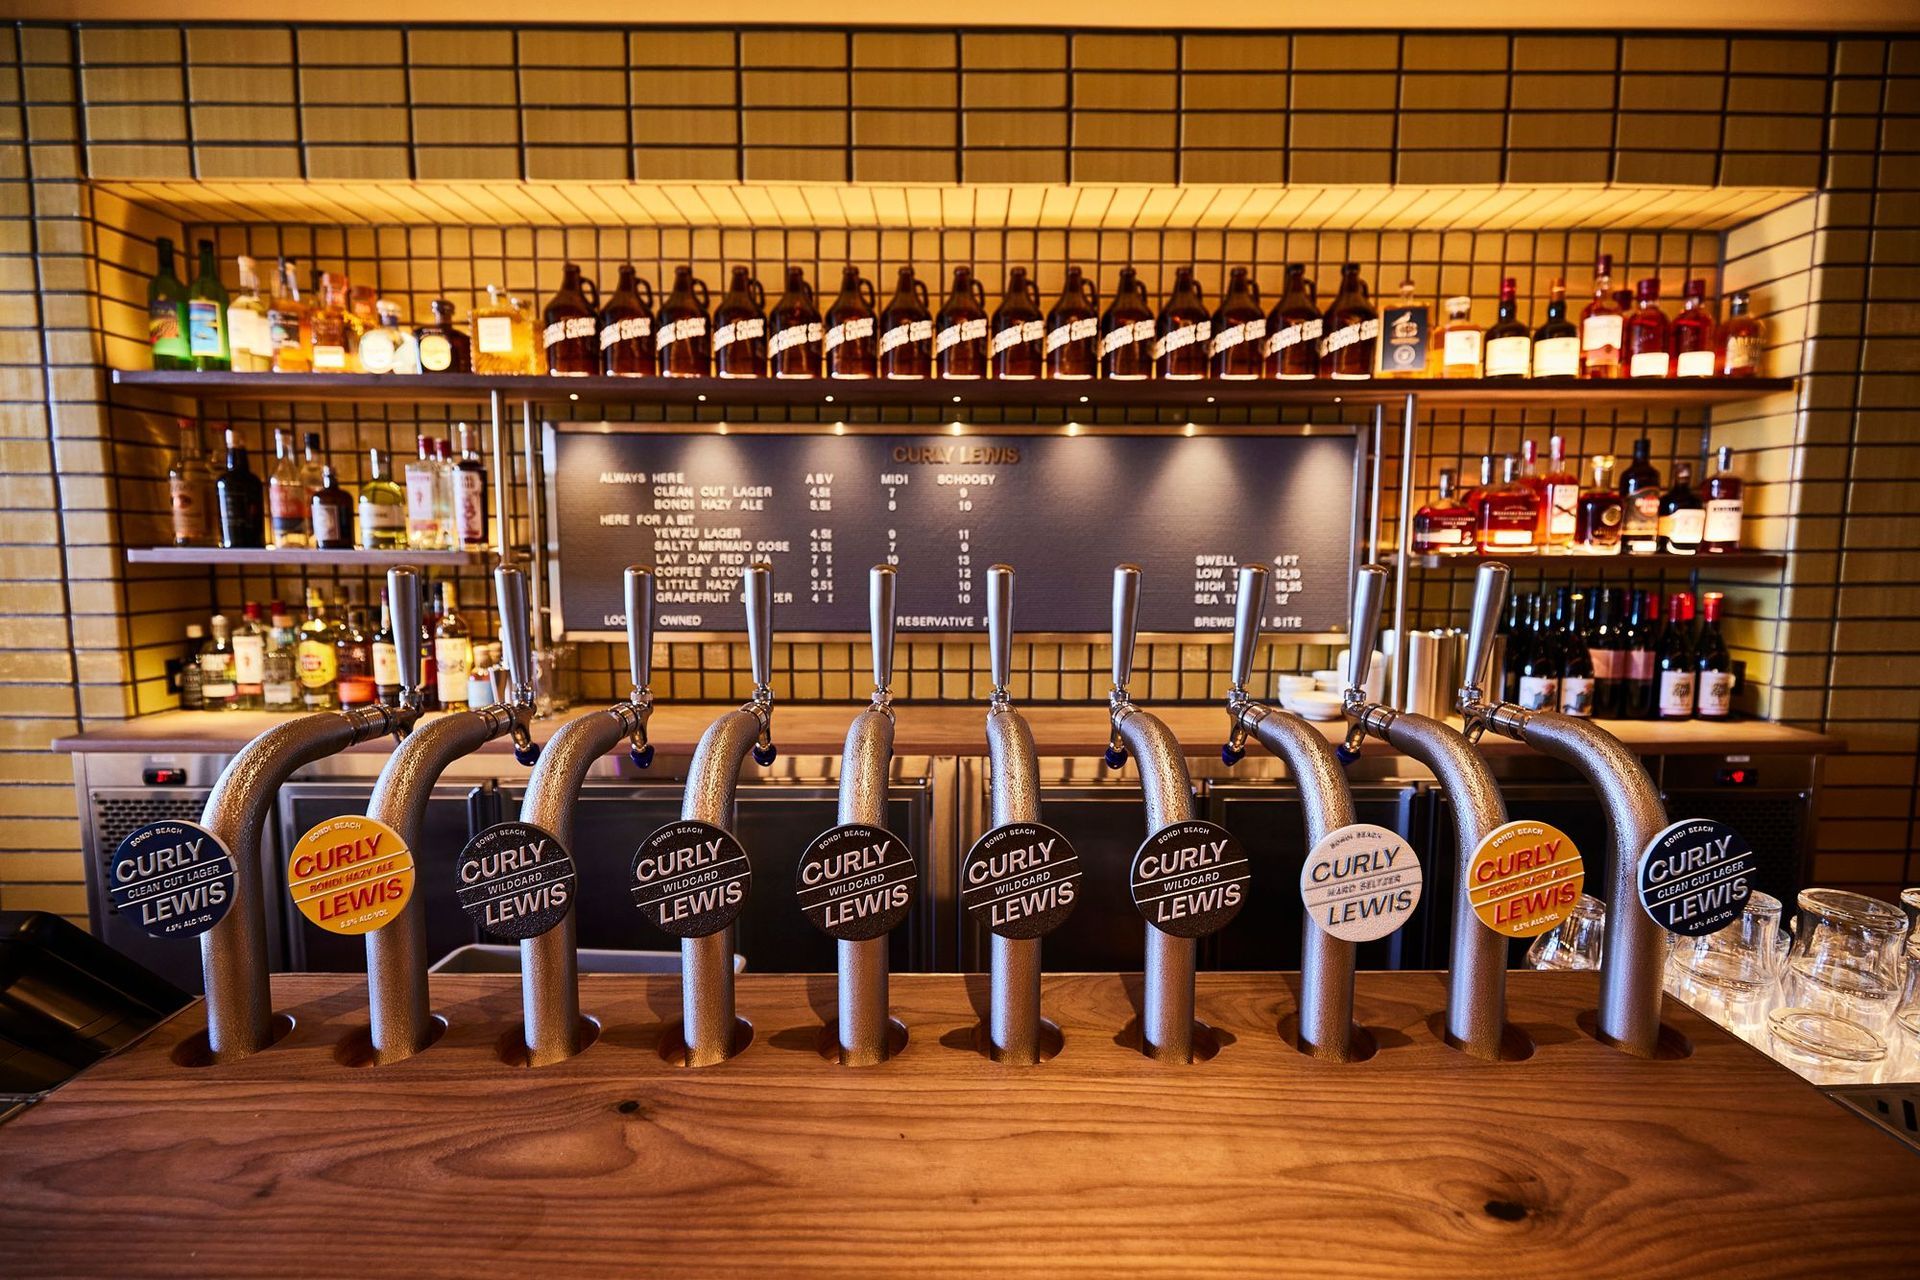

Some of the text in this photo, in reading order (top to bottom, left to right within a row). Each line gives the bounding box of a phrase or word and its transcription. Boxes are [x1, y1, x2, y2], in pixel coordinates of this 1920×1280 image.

[893, 446, 1020, 464] CURLY LEWIS
[600, 472, 684, 484] ALWAYS HERE
[804, 473, 834, 484] ABV
[881, 474, 908, 485] MIDI
[937, 474, 996, 485] SCHOOEY
[653, 486, 694, 497] CLEAN
[700, 486, 726, 497] CUT
[732, 486, 772, 497] LAGER
[889, 487, 896, 498] 7
[654, 499, 695, 510] BONDI
[701, 499, 732, 510] HAZY
[740, 499, 763, 510] ALE
[888, 500, 897, 511] 8
[959, 500, 973, 511] 10
[600, 514, 695, 526] HERE FOR A BIT
[654, 528, 699, 538] YEWZU
[704, 528, 741, 539] LAGER
[959, 529, 969, 540] 11
[654, 541, 694, 551] SALTY
[698, 541, 752, 551] MERMAID
[757, 541, 790, 552] GOSE
[889, 542, 896, 552] 7
[656, 553, 680, 564] LAY
[687, 553, 712, 564] DAY
[719, 553, 744, 564] RED
[750, 554, 772, 564] IPA
[887, 555, 899, 565] 10
[958, 555, 970, 566] 13
[1195, 555, 1237, 566] SWELL
[654, 566, 702, 577] COFFEE
[710, 566, 744, 577] STOU
[958, 568, 971, 579] 12
[1196, 568, 1223, 579] LOW
[656, 579, 699, 590] LITTLE
[706, 579, 738, 590] HAZY
[959, 581, 971, 591] 10
[1194, 581, 1226, 592] HIGH
[656, 592, 730, 603] GRAPEFRUIT
[958, 594, 971, 604] 10
[1194, 593, 1219, 604] SEA
[660, 615, 701, 626] OWNED
[897, 616, 974, 627] RESERVATIVE
[1194, 616, 1235, 627] BREWE
[1273, 617, 1302, 627] SITE
[130, 827, 183, 847] BONDI BEACH
[309, 822, 361, 842] BONDI BEACH
[475, 833, 497, 849] BONDI
[651, 830, 674, 847] BONDI
[819, 833, 841, 850] BONDI
[984, 828, 1036, 849] BONDI BEACH
[1157, 827, 1210, 844] BONDI BEACH
[1493, 831, 1515, 848] BONDI
[1664, 825, 1714, 848] BONDI BEACH
[116, 838, 204, 882] CURLY
[294, 832, 383, 878] CURLY
[461, 839, 546, 883] CURLY
[636, 837, 723, 882] CURLY
[802, 840, 890, 885] CURLY
[968, 838, 1056, 884] CURLY
[1139, 839, 1228, 879] CURLY
[1311, 845, 1400, 883] CURLY
[1476, 838, 1561, 882] CURLY
[1648, 834, 1732, 883] CURLY
[127, 865, 220, 899] CLEAN CUT LAGER
[309, 861, 395, 893] BONDI HAZY ALE
[488, 872, 542, 895] WILDCARD
[662, 870, 718, 893] WILDCARD
[829, 873, 885, 897] WILDCARD
[995, 871, 1051, 895] WILDCARD
[1163, 872, 1220, 892] WILDCARD
[1657, 861, 1744, 899] CLEAN CUT LAGER
[142, 882, 227, 925] LEWIS
[319, 877, 403, 921] LEWIS
[486, 883, 567, 926] LEWIS
[660, 881, 743, 925] LEWIS
[826, 884, 909, 928] LEWIS
[991, 882, 1075, 927] LEWIS
[1157, 884, 1241, 923] LEWIS
[1328, 889, 1412, 926] LEWIS
[1494, 881, 1576, 925] LEWIS
[1669, 877, 1748, 925] LEWIS
